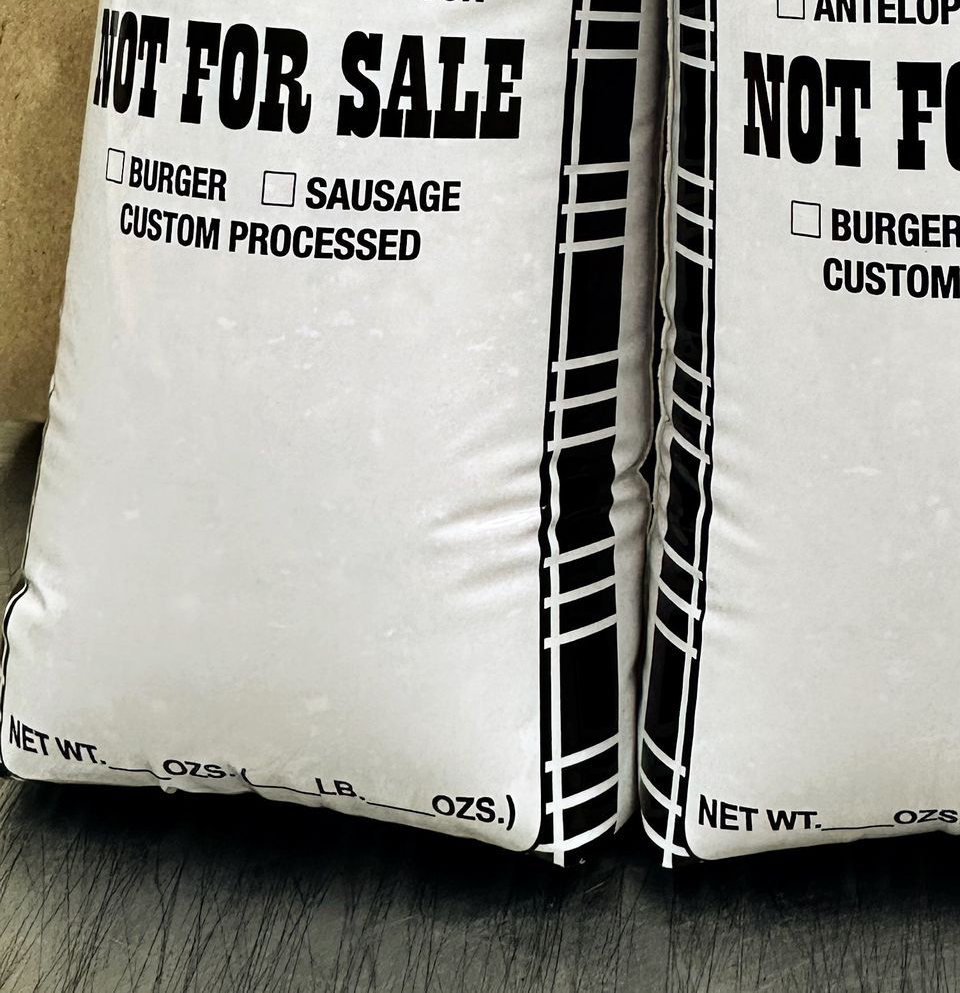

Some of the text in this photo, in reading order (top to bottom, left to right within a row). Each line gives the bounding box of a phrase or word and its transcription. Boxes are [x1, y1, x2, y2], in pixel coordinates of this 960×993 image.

[93, 9, 525, 139] NOT FOR SALE
[744, 51, 870, 167] NOT
[129, 156, 461, 212] BURGER SAUSAGE
[121, 203, 420, 260] CUSTOM PROCESSED
[824, 258, 960, 298] CUSTOM
[9, 715, 50, 756] NET
[54, 736, 107, 765] WT.
[315, 778, 365, 801] LB.
[431, 794, 516, 830] OZS.)
[698, 795, 758, 831] NET
[764, 810, 821, 831] WT.
